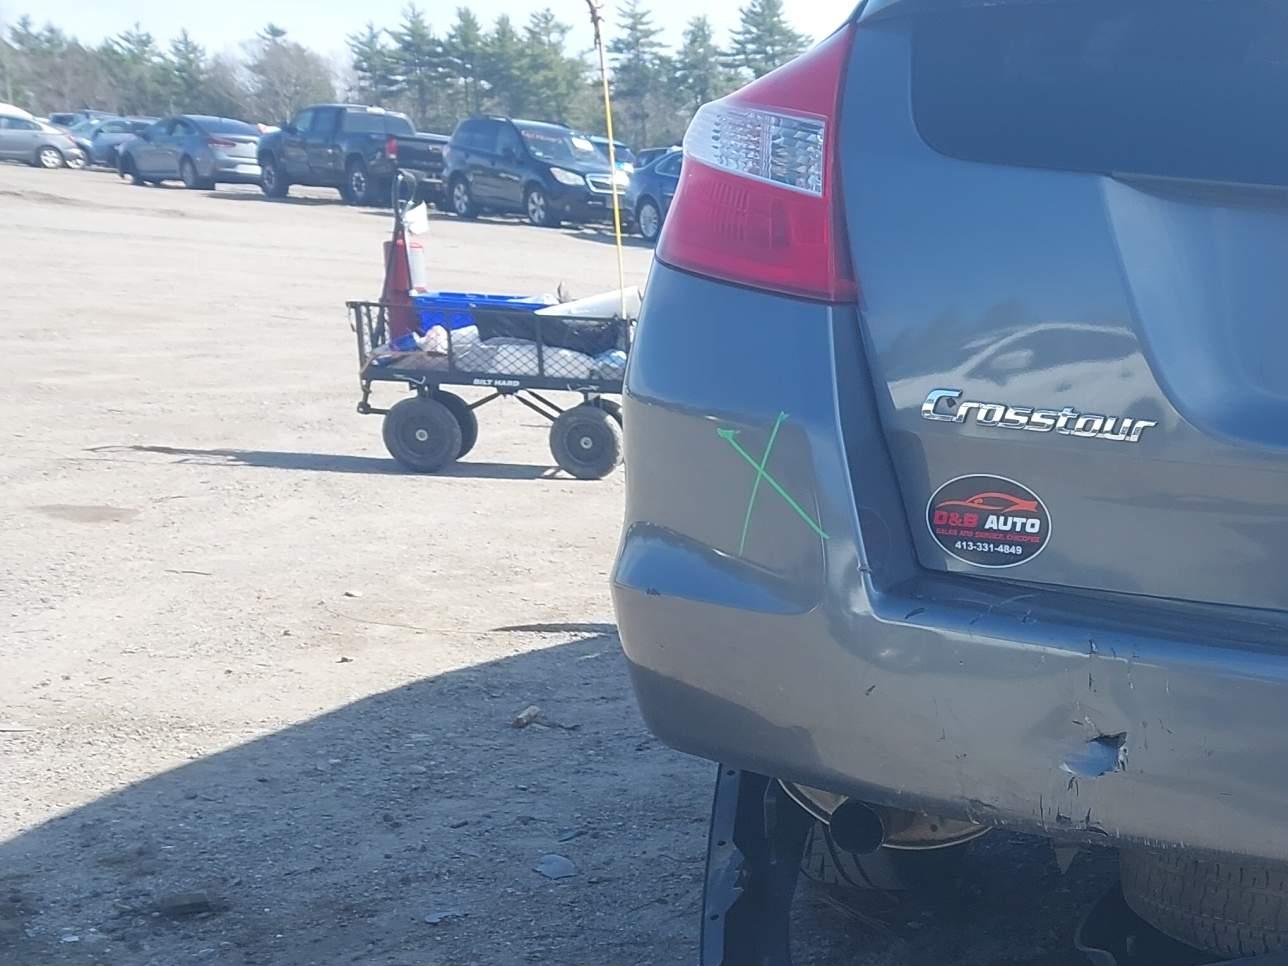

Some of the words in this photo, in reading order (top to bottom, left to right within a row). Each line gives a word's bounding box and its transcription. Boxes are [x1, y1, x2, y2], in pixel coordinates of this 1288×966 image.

[920, 388, 1158, 443] Crosstour
[933, 511, 979, 528] D&B
[984, 514, 1041, 534] AUTO
[955, 540, 1023, 555] 413-331-4849
